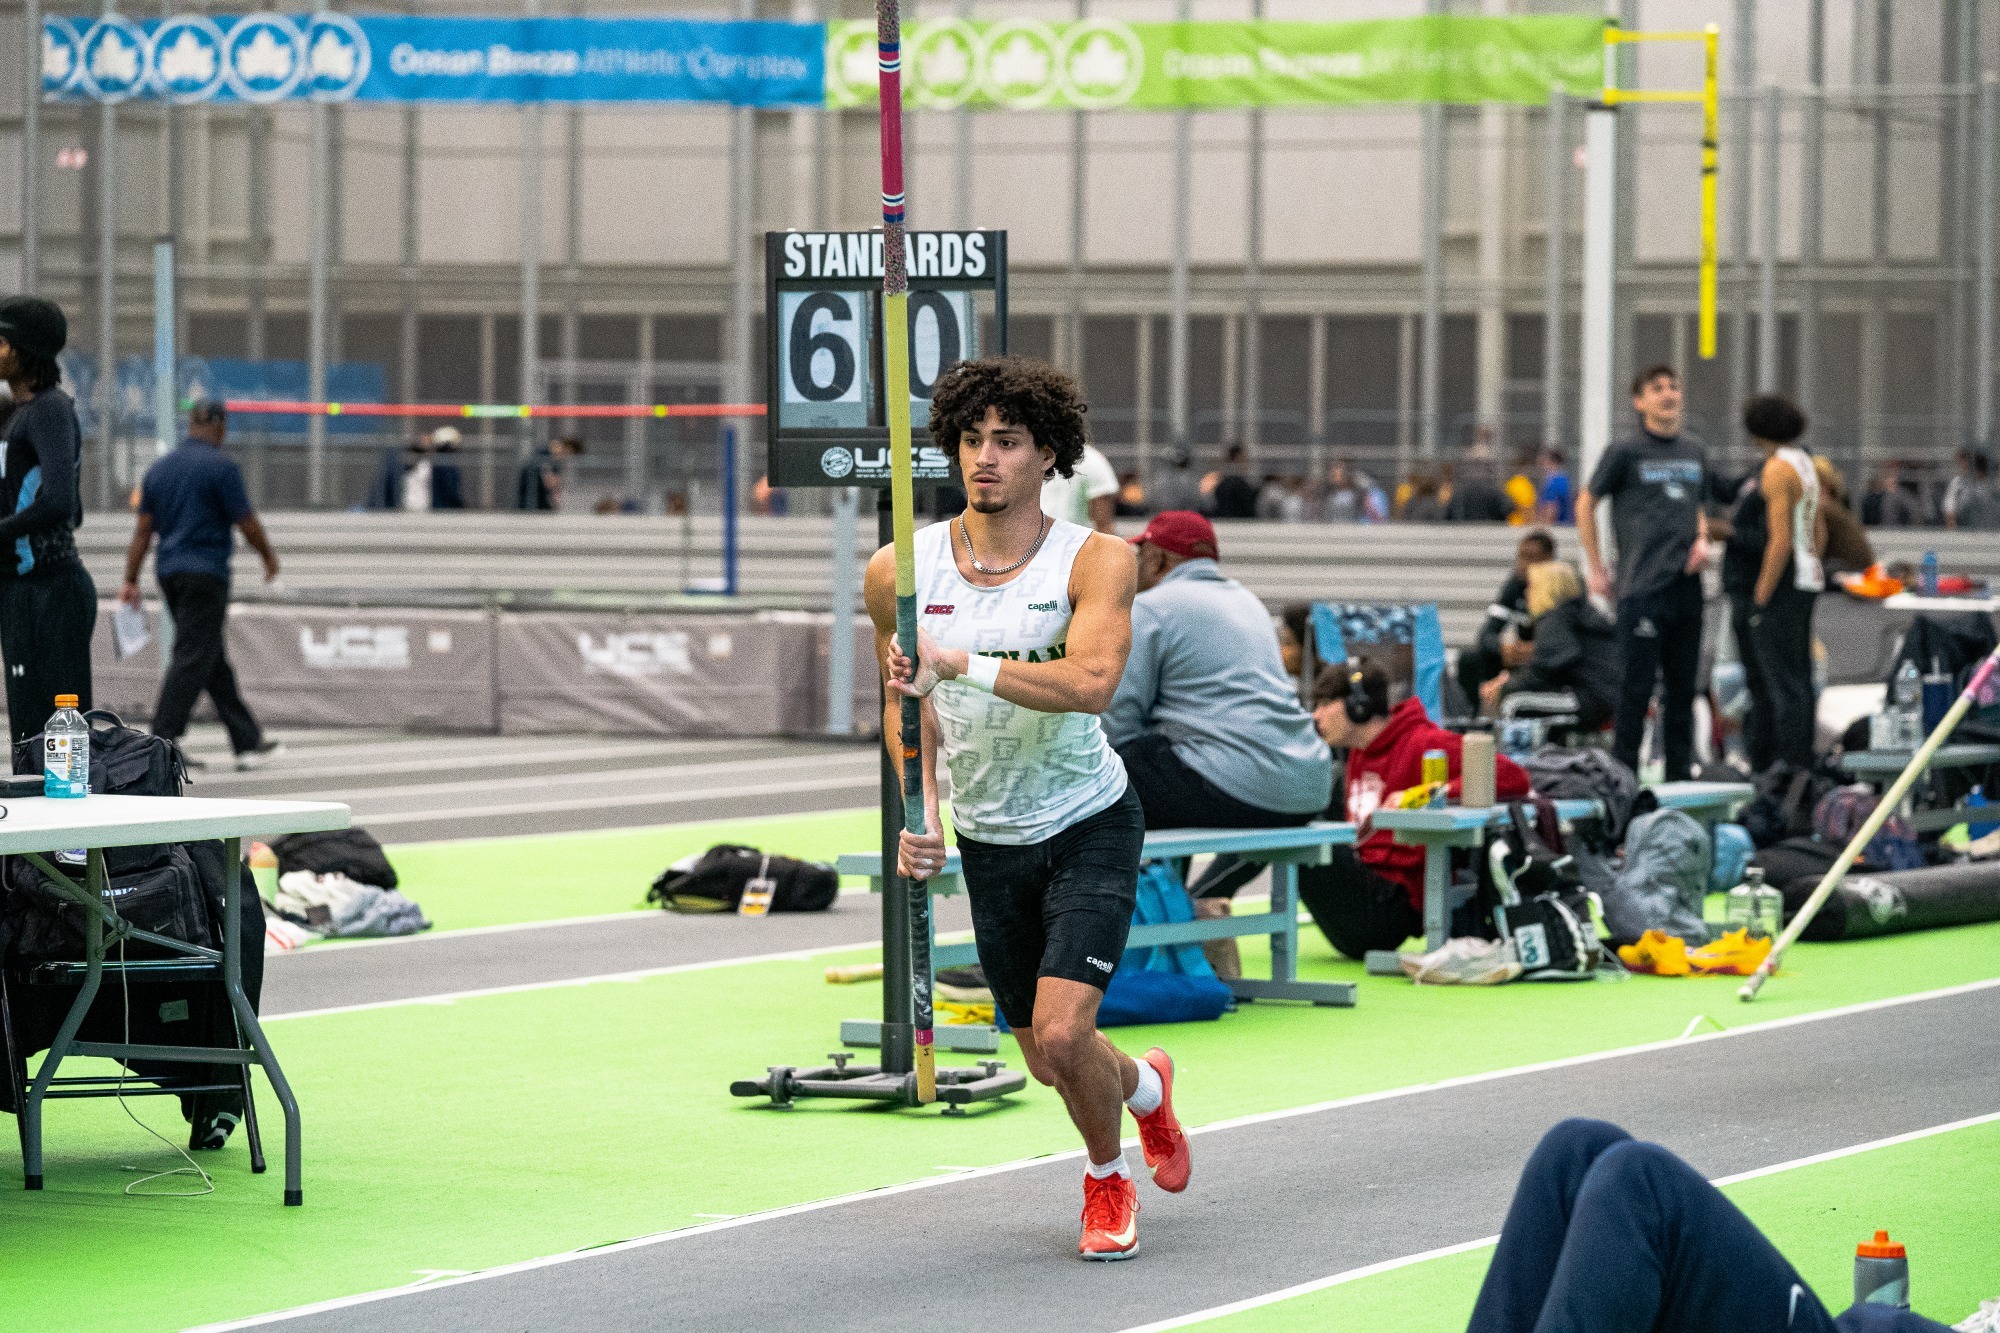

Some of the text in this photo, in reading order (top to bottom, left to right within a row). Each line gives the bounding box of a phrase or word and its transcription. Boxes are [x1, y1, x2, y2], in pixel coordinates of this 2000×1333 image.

[784, 233, 986, 277] STANDRDS
[789, 289, 961, 402] 6 0
[1028, 600, 1058, 611] capelli
